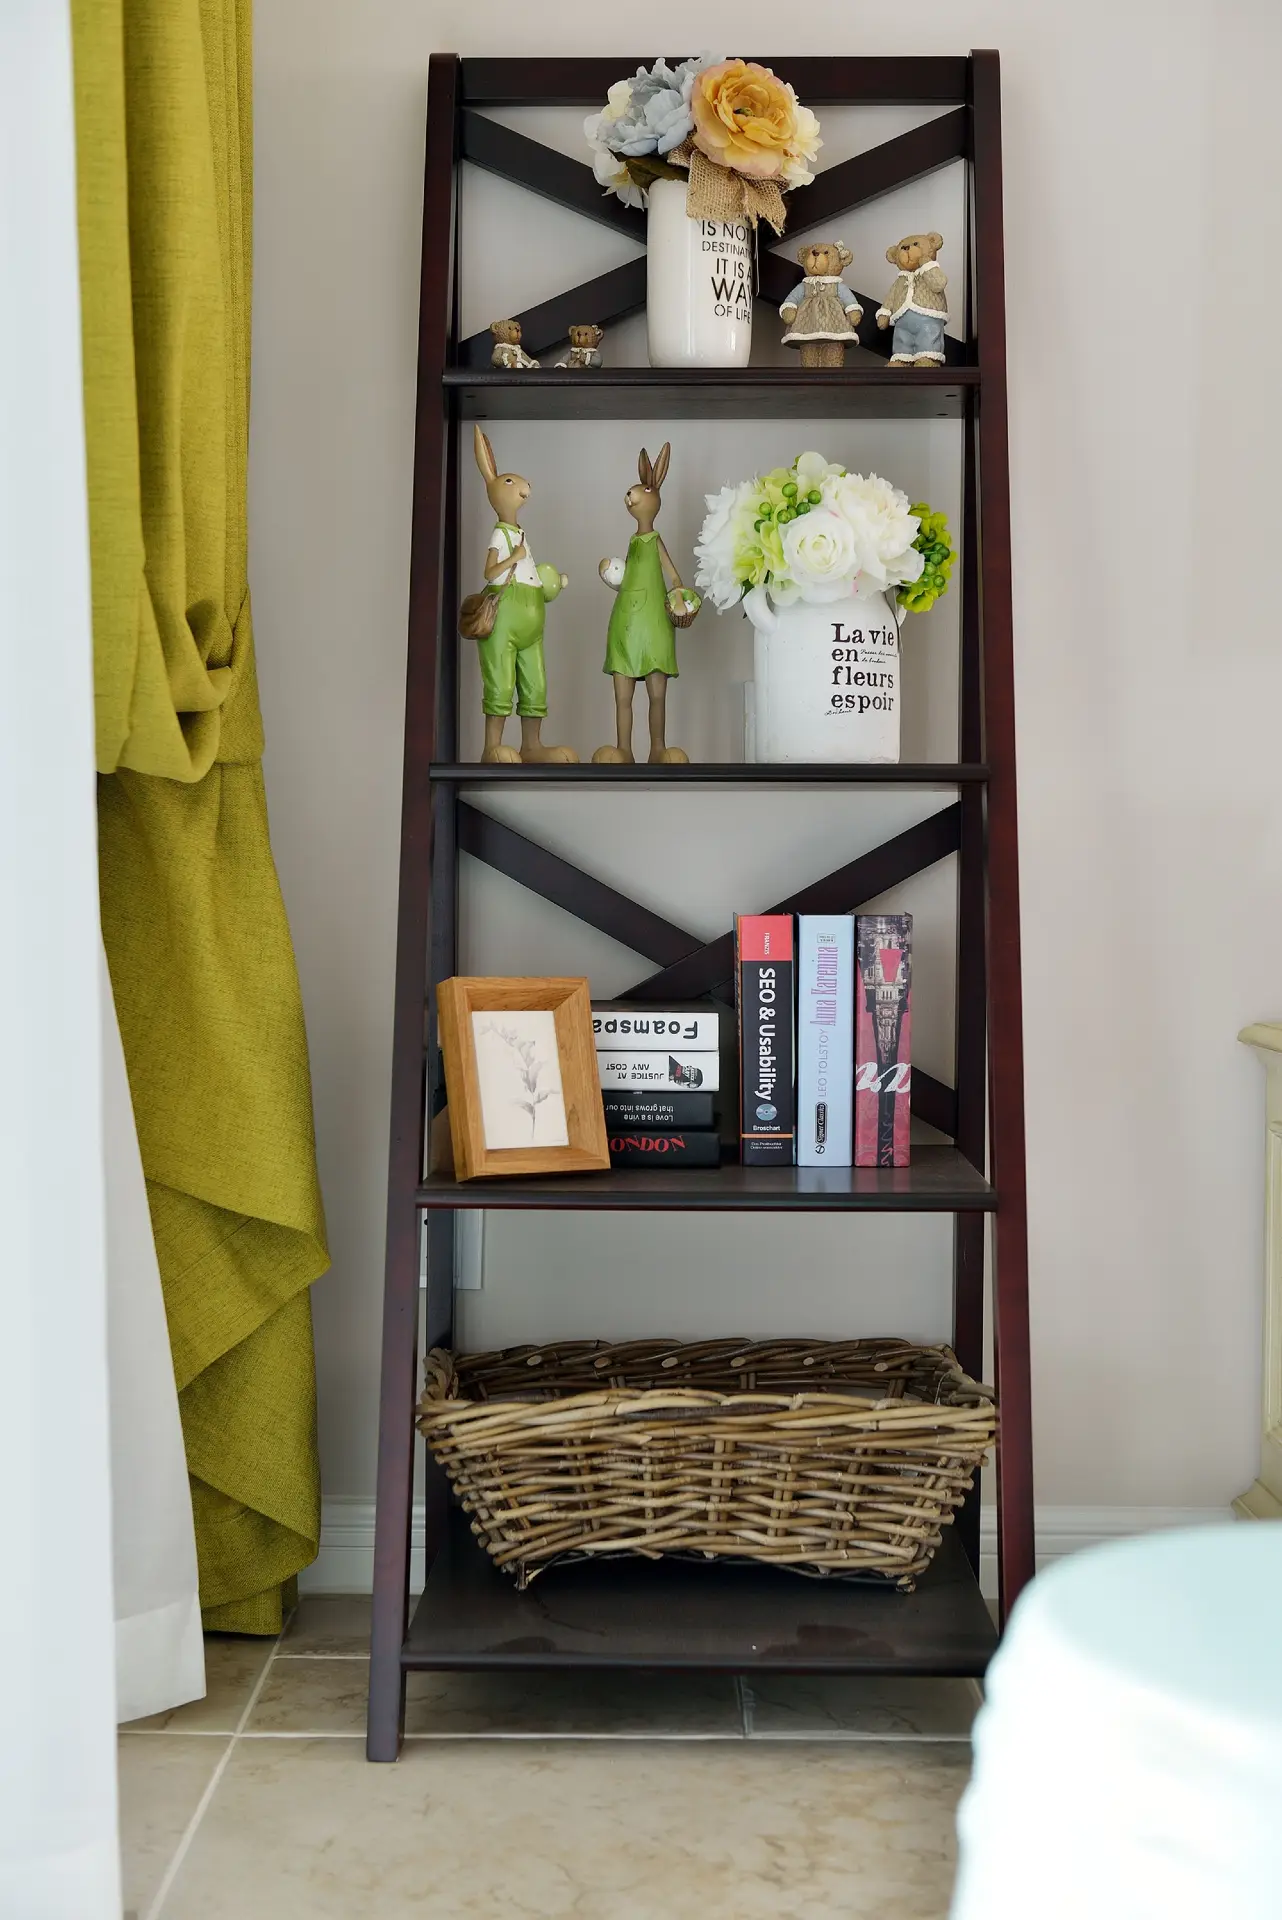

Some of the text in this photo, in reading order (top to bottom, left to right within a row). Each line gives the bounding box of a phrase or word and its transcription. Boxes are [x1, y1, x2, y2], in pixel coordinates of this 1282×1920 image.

[702, 219, 716, 236] IS
[716, 258, 728, 274] IT
[734, 261, 744, 279] IS
[711, 277, 752, 308] WAY
[714, 304, 751, 324] OF LIFE
[831, 623, 894, 646] La vie
[831, 648, 859, 662] en
[831, 665, 894, 688] fleurs
[831, 691, 894, 713] espoir
[763, 932, 771, 955] FRANZIS
[810, 946, 839, 995] Karenina
[810, 1000, 837, 1026] Anna
[755, 968, 776, 1101] SEO & Usability
[606, 1063, 650, 1071] ANY COST
[818, 1028, 829, 1097] LEO TOLSTOY
[617, 1072, 664, 1080] JUSTICE AT
[606, 1103, 674, 1113] that grows into our
[623, 1114, 640, 1122] vine
[647, 1114, 654, 1122] is
[656, 1114, 674, 1122] Love
[607, 1135, 686, 1153] ONDON
